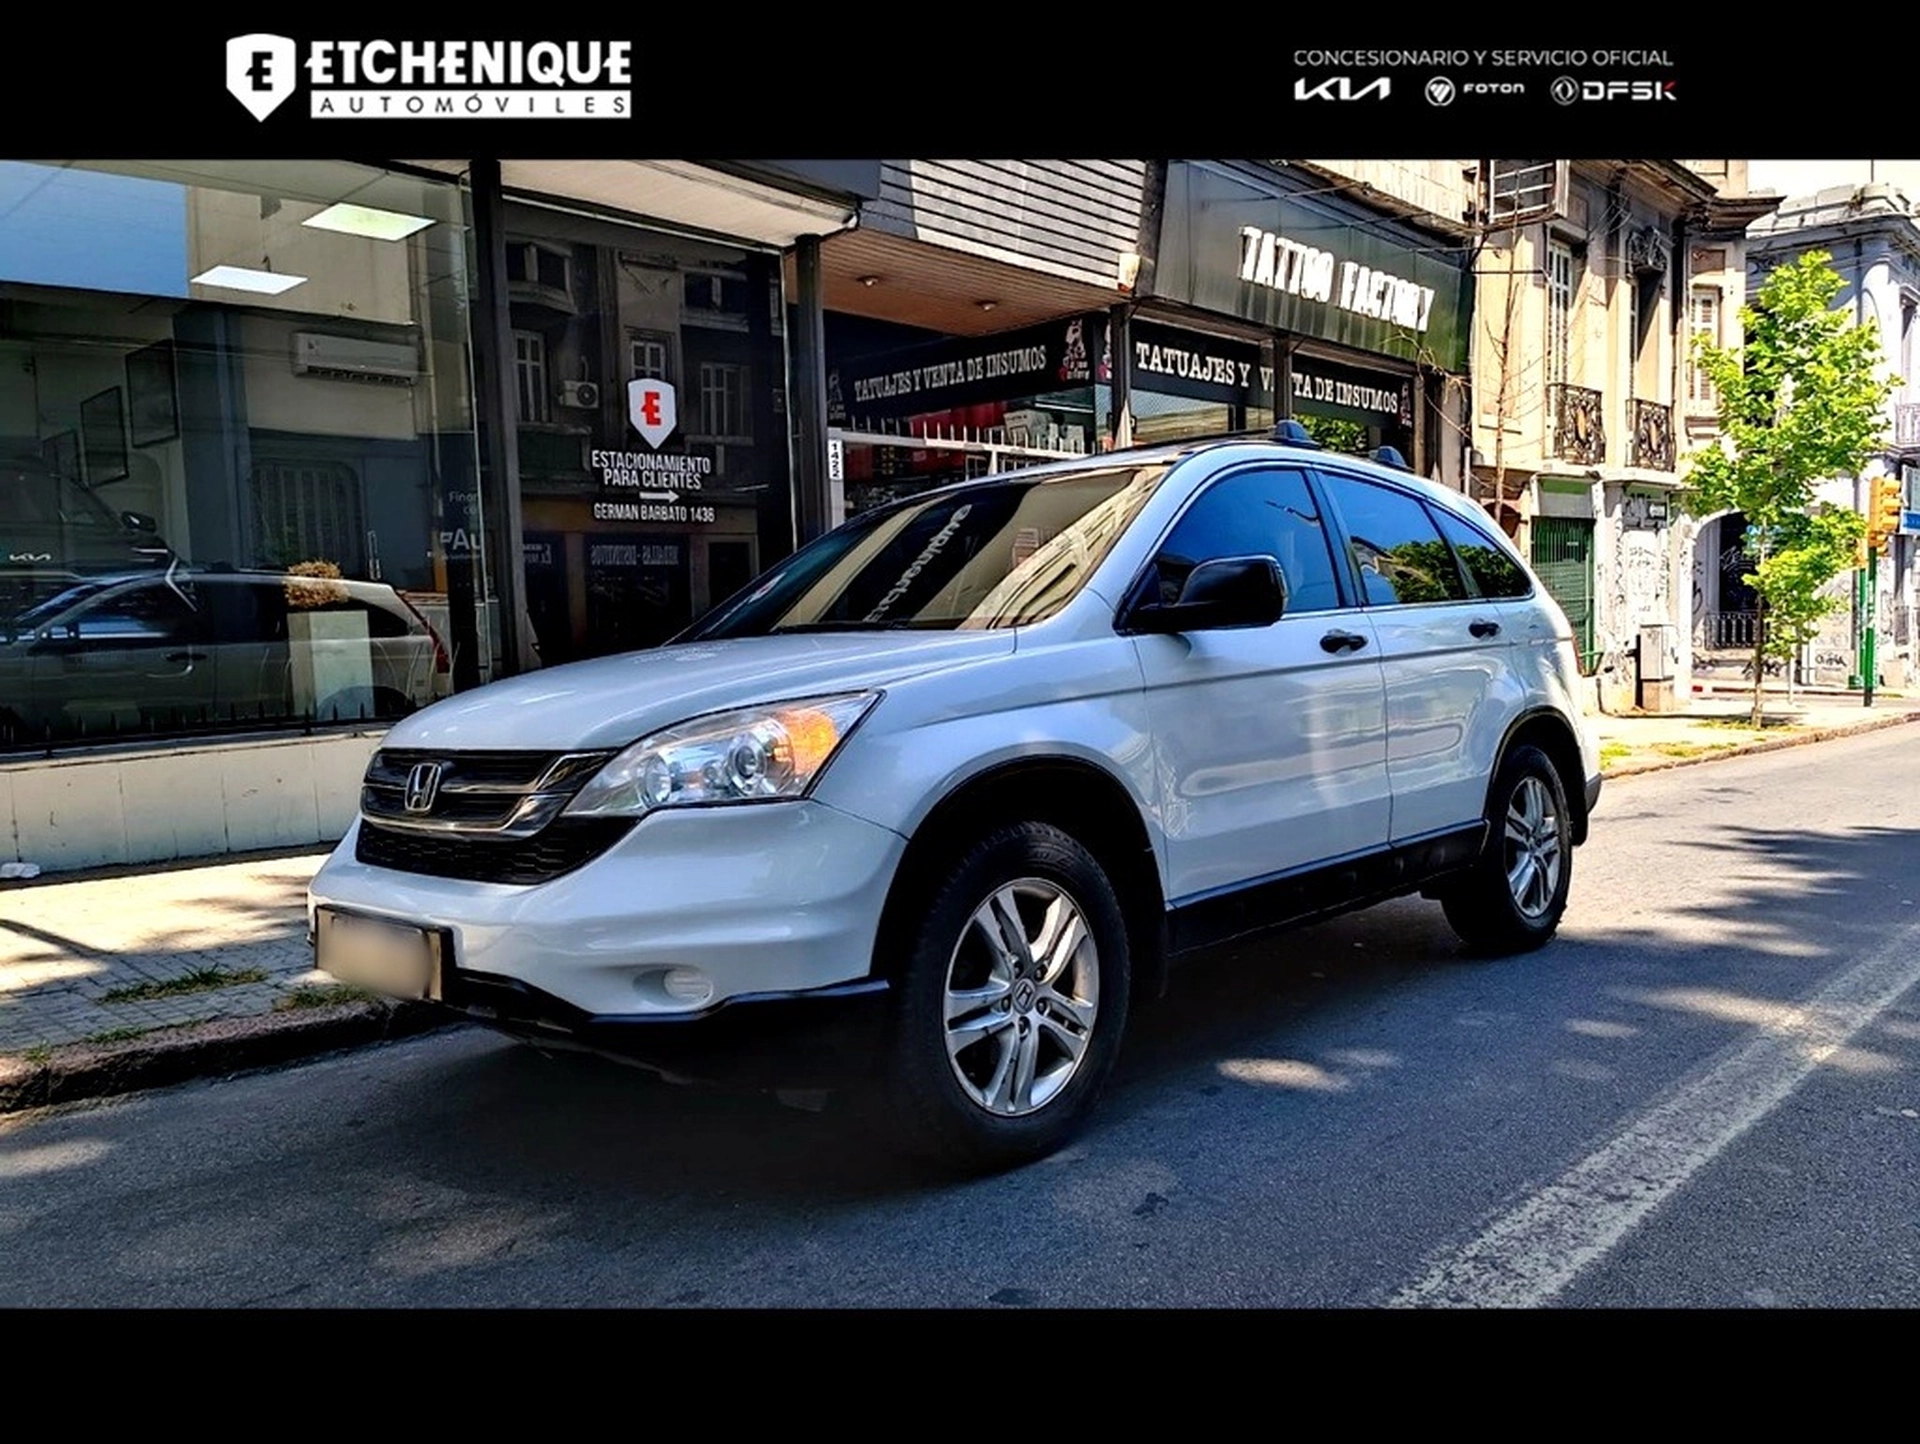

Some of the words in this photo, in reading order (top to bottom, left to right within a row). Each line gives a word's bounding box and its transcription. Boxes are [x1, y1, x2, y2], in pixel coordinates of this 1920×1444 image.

[854, 370, 912, 402] TATUAJES
[913, 368, 923, 392] Y
[924, 358, 965, 390] VENTA
[967, 354, 984, 381] DE
[986, 345, 1047, 378] INSUMOS
[1136, 342, 1236, 386] TATUAJES
[1238, 362, 1251, 388] Y
[1260, 366, 1313, 400] VTA
[1315, 378, 1334, 402] DE
[1336, 382, 1399, 414] INSUMOS
[591, 449, 711, 474] ESTACIONAMIENTO
[603, 468, 640, 487] PARA
[642, 470, 702, 490] CLIENTES
[593, 503, 639, 520] GERMAN
[640, 504, 687, 522] BARBATO
